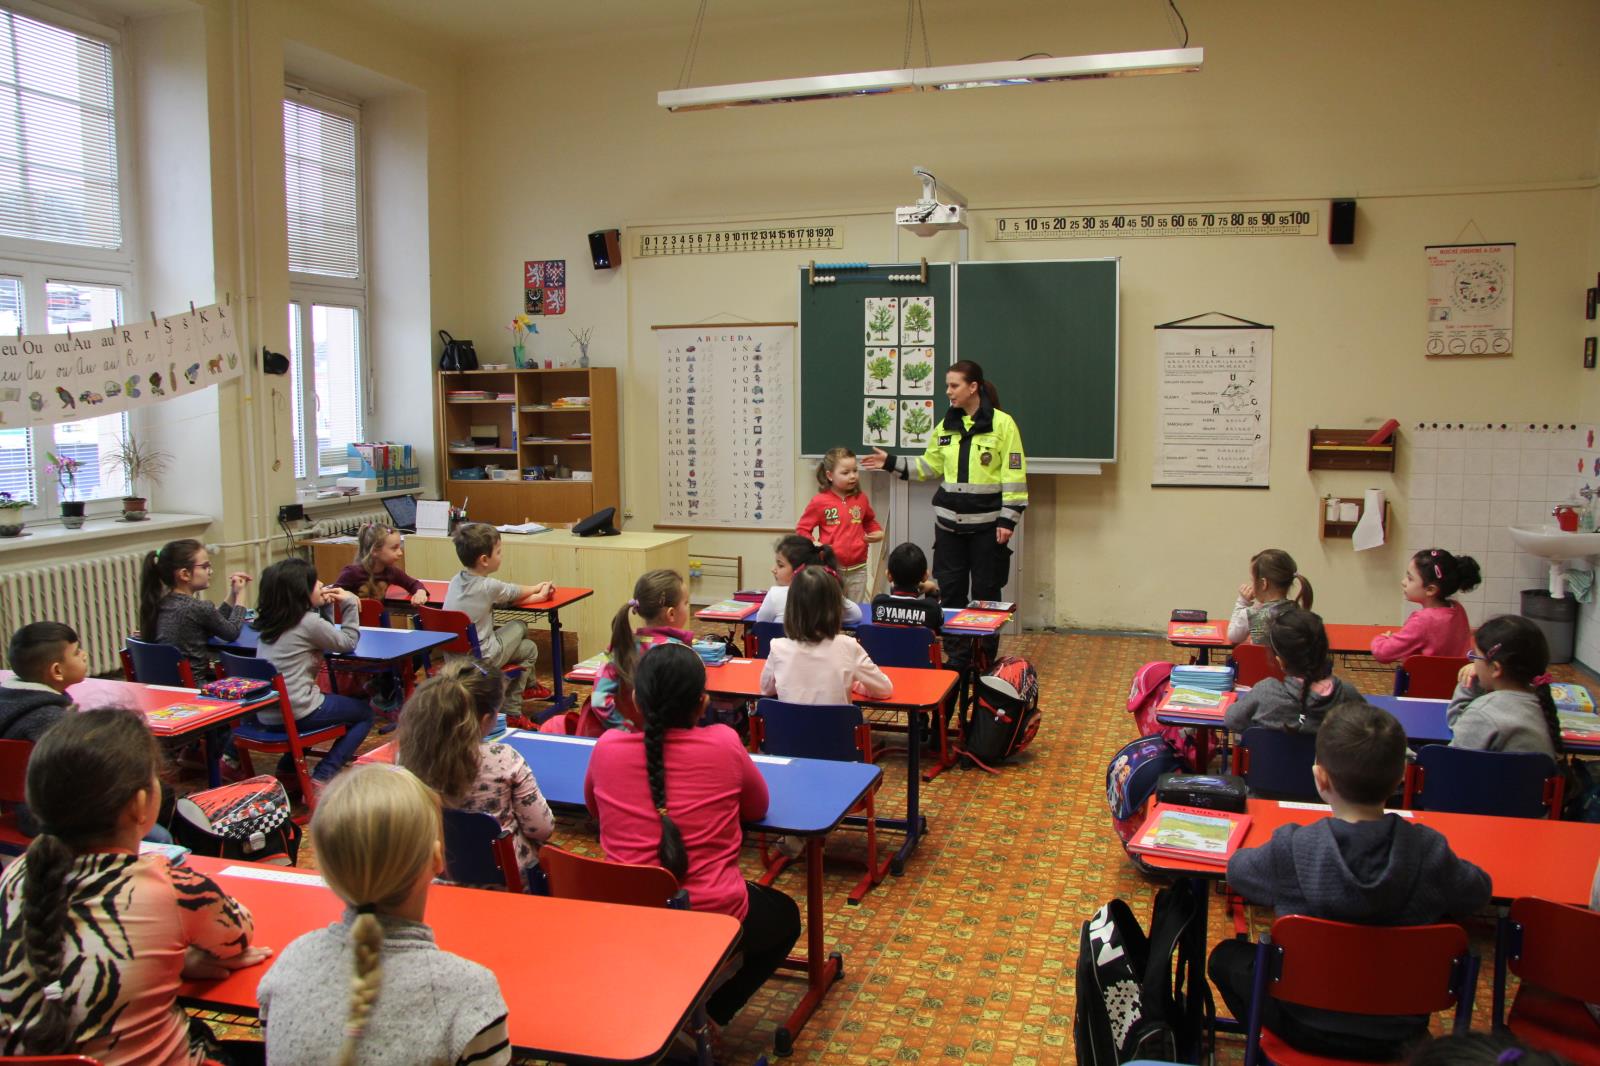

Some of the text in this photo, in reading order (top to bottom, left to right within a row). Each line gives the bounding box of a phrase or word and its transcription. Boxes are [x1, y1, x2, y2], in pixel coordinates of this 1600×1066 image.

[999, 212, 1310, 231] 0 5 10 15 20 25 30 35 40 45 50 55 60 65 70 75 80 85 90 95 100
[645, 228, 834, 245] 0 1 2 3 4 5 6 7 8 9 10 11 12 13 14 15 16 17 18 19 20
[1, 345, 18, 356] eu
[23, 340, 43, 354] Ou
[54, 343, 70, 353] ou
[73, 337, 92, 351] Au
[101, 336, 115, 347] au
[122, 330, 133, 343] R
[144, 330, 150, 339] r
[199, 311, 208, 323] K
[218, 307, 225, 318] k
[825, 508, 838, 519] 22
[886, 607, 926, 622] YAMAHA
